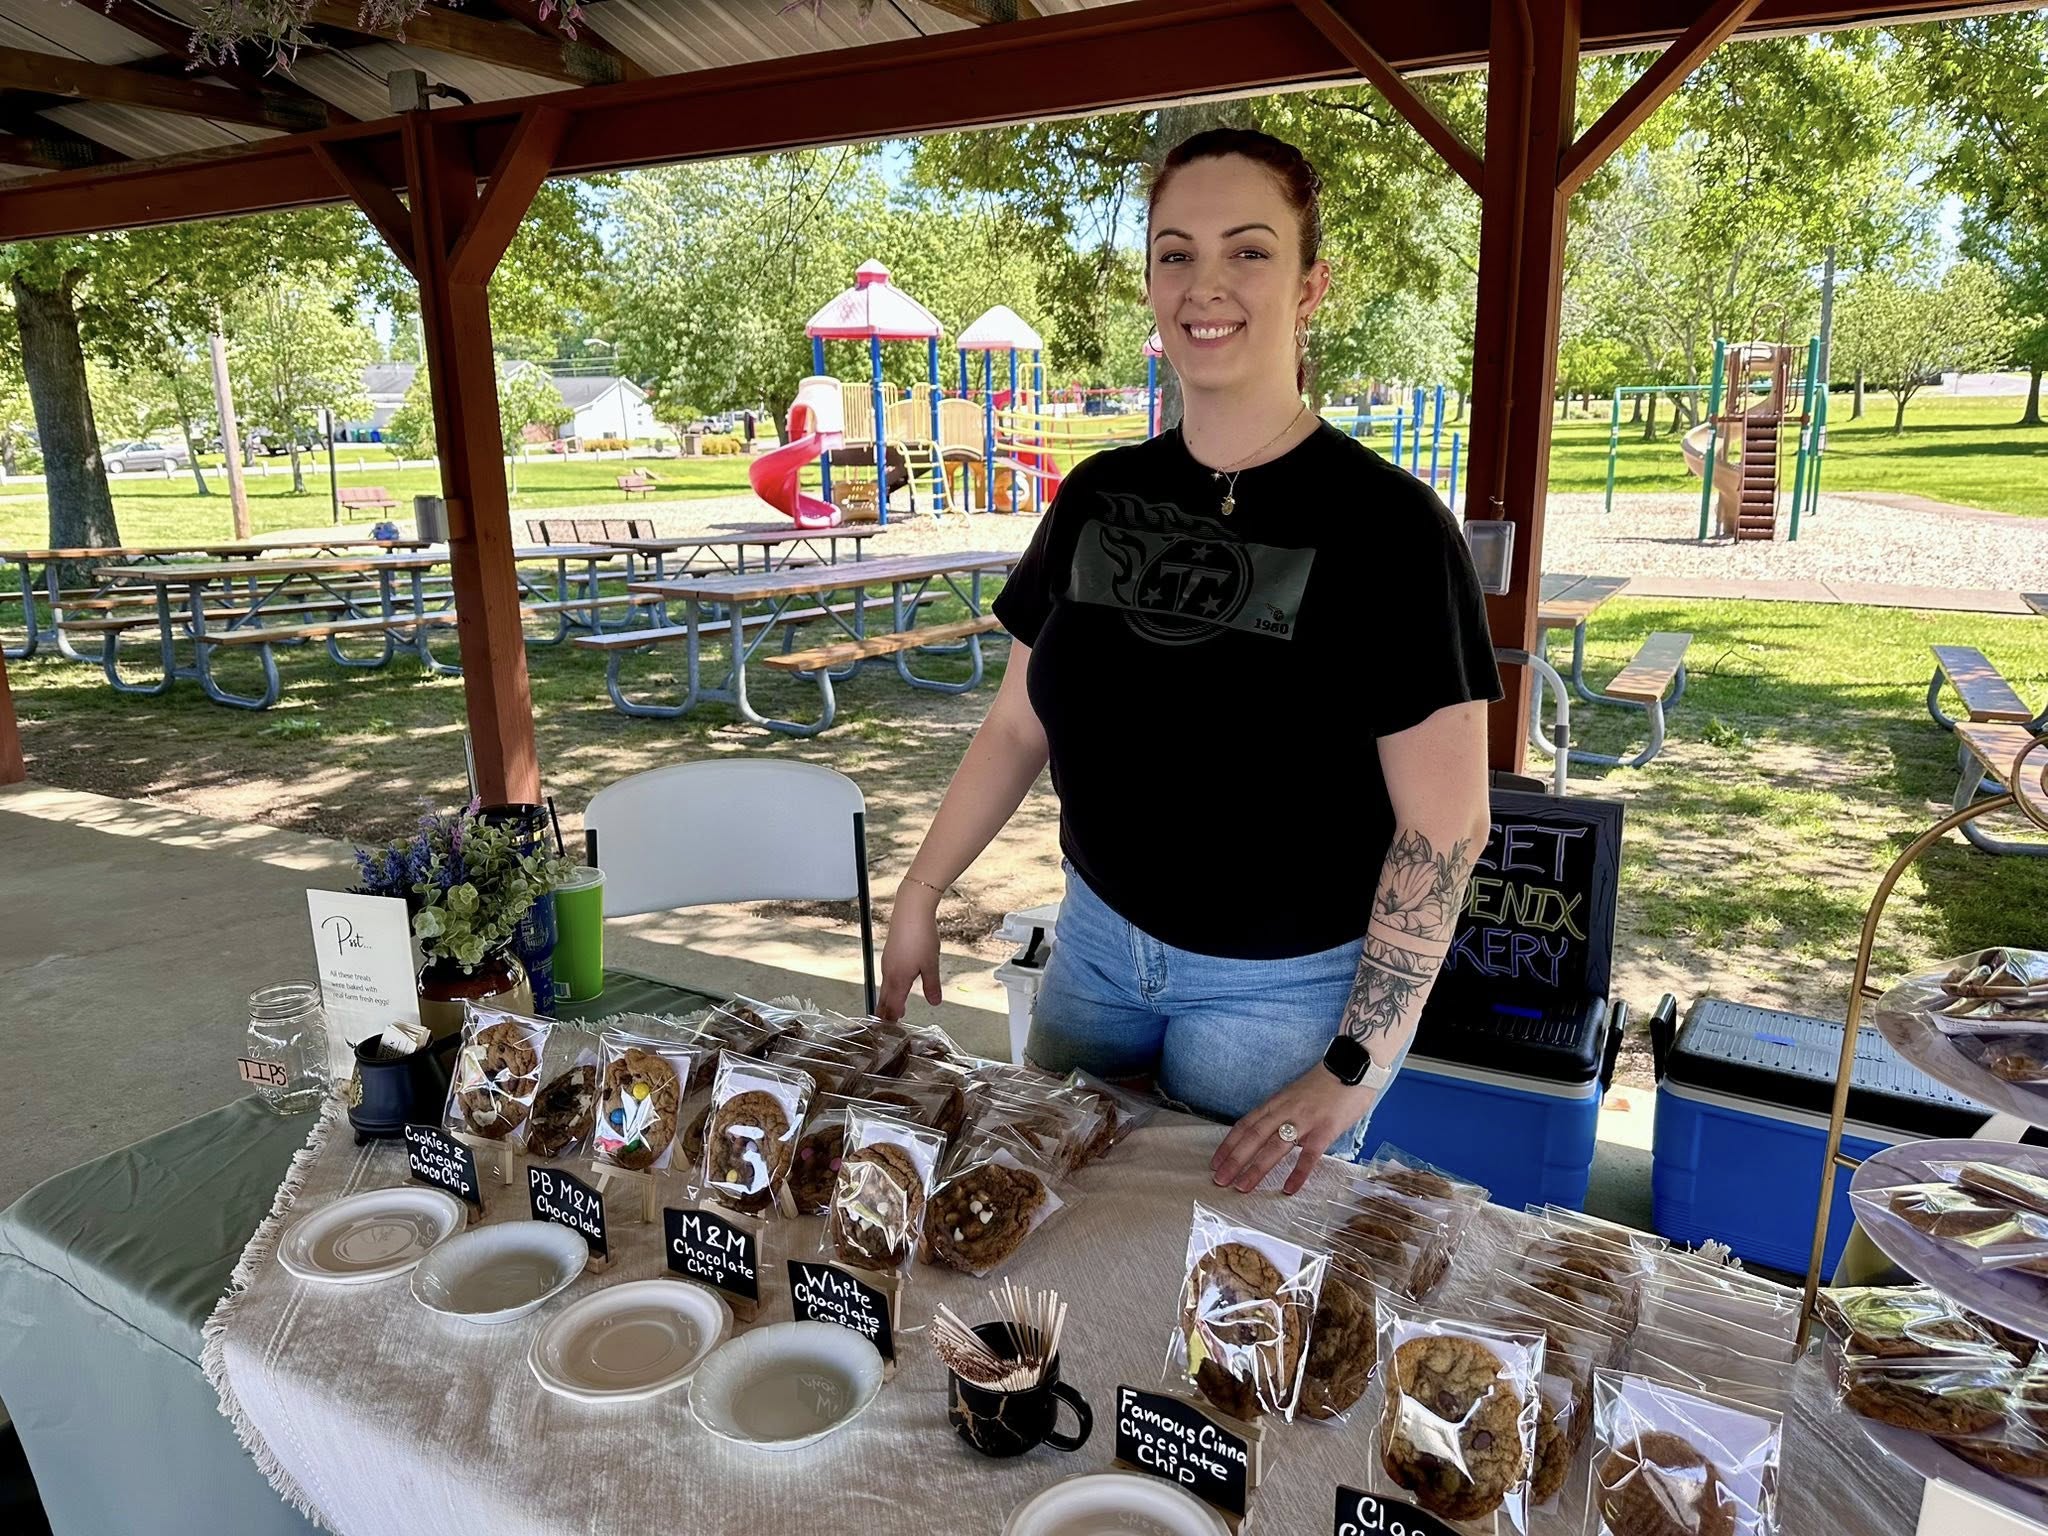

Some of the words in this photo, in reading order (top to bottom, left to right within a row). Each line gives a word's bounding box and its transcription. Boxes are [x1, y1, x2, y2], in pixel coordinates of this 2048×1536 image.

[338, 971, 353, 979] these
[354, 973, 371, 982] treats
[1444, 925, 1568, 987] KERY
[344, 992, 359, 1000] farm
[359, 994, 374, 1003] fresh
[345, 982, 363, 991] baked
[364, 985, 378, 993] with
[237, 1058, 287, 1086] TIPS
[405, 1125, 450, 1153] Cookies
[453, 1146, 468, 1163] &
[420, 1145, 464, 1173] Cream
[530, 1169, 554, 1195] PB
[560, 1179, 600, 1219] M&M
[536, 1195, 602, 1238] Chocolate
[682, 1214, 746, 1258] M&M
[673, 1238, 754, 1280] Chocolate
[687, 1258, 724, 1283] Chip
[794, 1283, 880, 1328] Chocolate
[802, 1265, 873, 1309] White
[1121, 1388, 1196, 1444] Famous
[1199, 1425, 1248, 1467] Cinna
[1120, 1418, 1229, 1481] Chocolate
[1137, 1444, 1196, 1484] Chip
